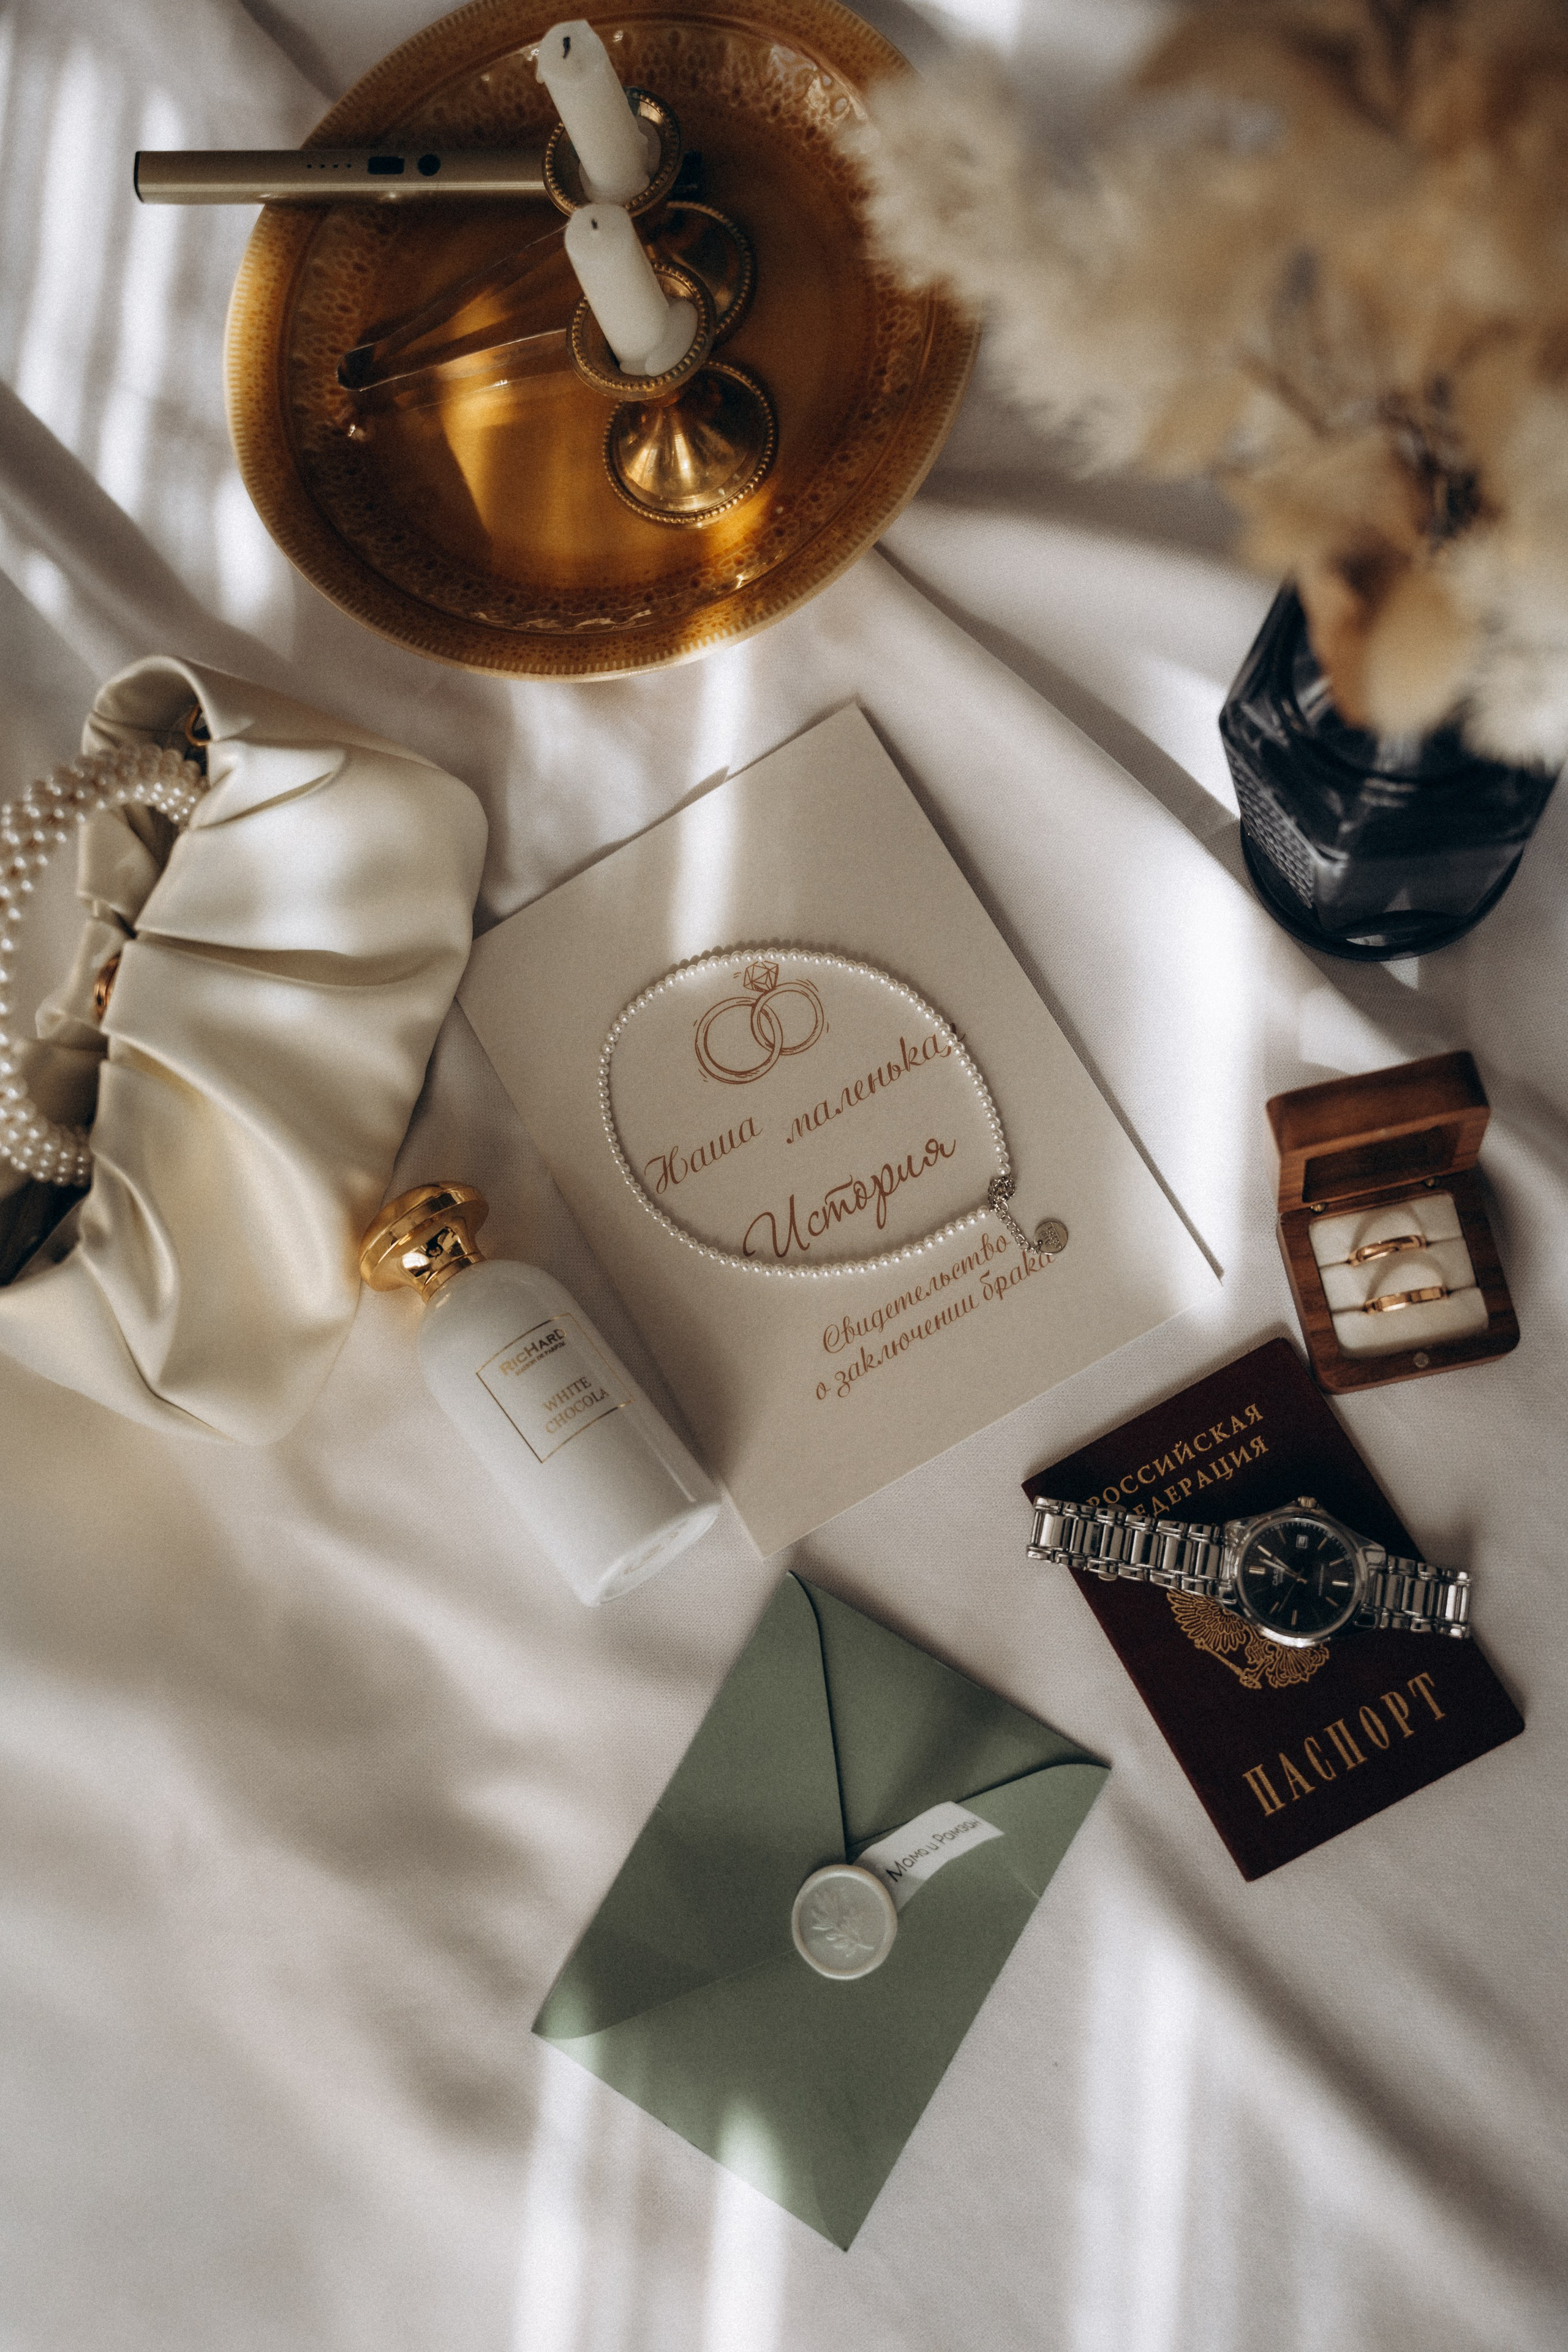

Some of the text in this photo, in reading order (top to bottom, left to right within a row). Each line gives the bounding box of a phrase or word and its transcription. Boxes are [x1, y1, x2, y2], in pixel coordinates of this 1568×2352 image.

[644, 1117, 763, 1194] Наша
[742, 1137, 956, 1259] История
[815, 1248, 1057, 1401] о заключении брака
[822, 1233, 1011, 1354] Свидетельство
[499, 1328, 567, 1376] RICHARD
[543, 1377, 592, 1412] WHITE
[546, 1389, 609, 1434] CHOCOLA
[1085, 1402, 1265, 1508] РОССИЙСКАЯ
[1132, 1434, 1269, 1518] ЕДЕРАЦИЯ
[1241, 1672, 1447, 1817] ПАСПОРТ
[932, 1819, 982, 1845] Рамзан
